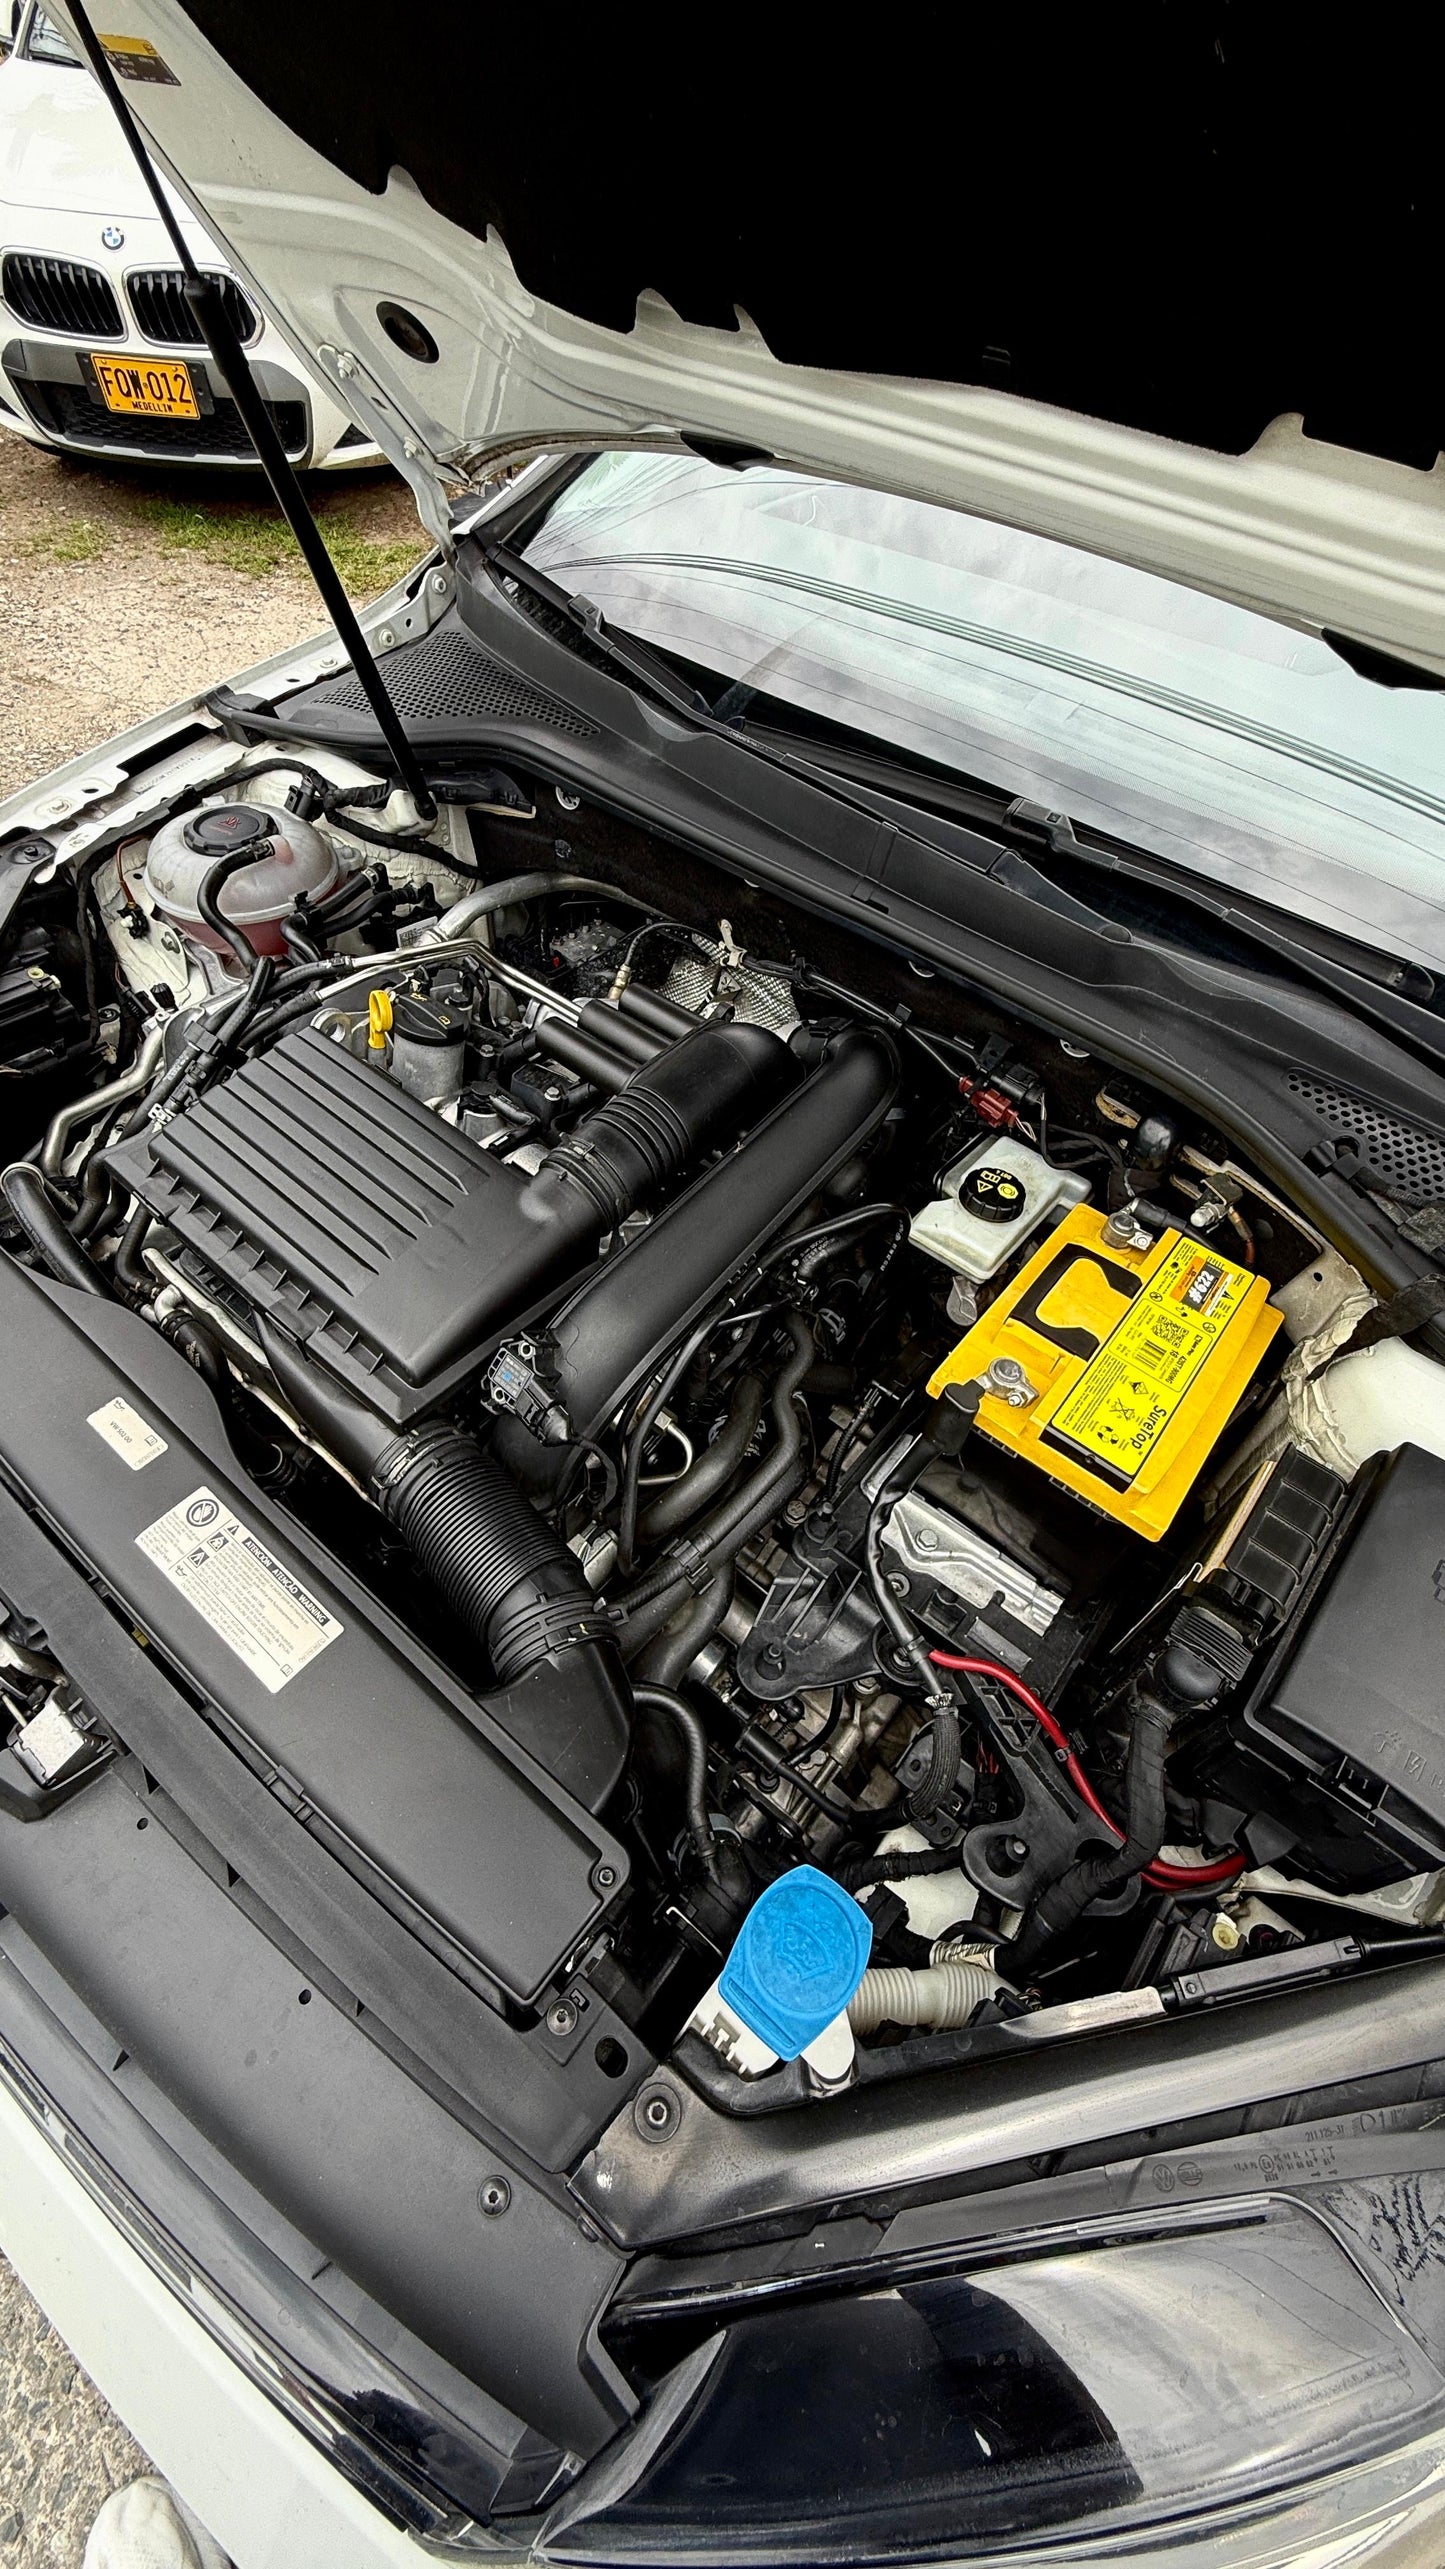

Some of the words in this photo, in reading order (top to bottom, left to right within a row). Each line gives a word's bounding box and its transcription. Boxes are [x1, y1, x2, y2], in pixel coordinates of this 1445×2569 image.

[131, 401, 174, 413] MEDELLIN
[1188, 1270, 1215, 1303] #622
[109, 1419, 120, 1430] VW
[116, 1427, 127, 1438] 502
[123, 1434, 132, 1444] 00
[1130, 1405, 1167, 1450] SureTop
[297, 1593, 326, 1623] WARNING
